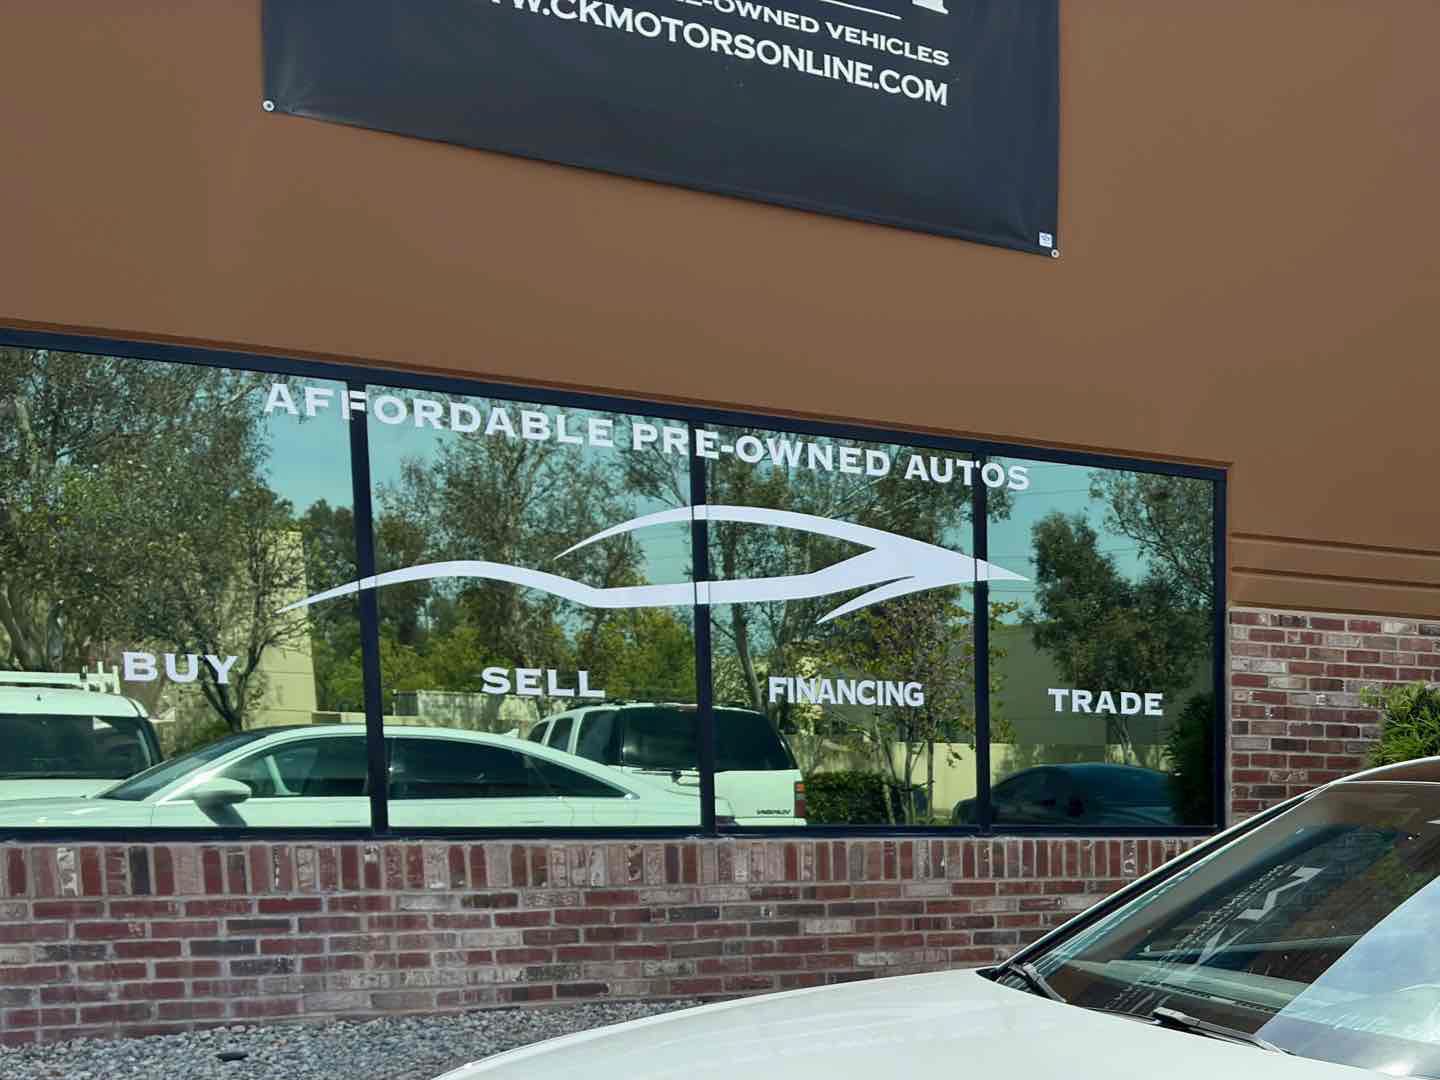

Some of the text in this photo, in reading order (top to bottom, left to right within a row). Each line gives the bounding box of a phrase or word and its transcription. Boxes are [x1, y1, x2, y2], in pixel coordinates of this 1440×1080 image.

[825, 22, 950, 66] VEHICLES
[263, 383, 1031, 491] AFFORDABLE PRE-OWNED AUTOS
[122, 651, 238, 685] BUY
[481, 667, 606, 698] SELL
[768, 676, 924, 707] FINANCING
[1047, 688, 1164, 716] TRADE
